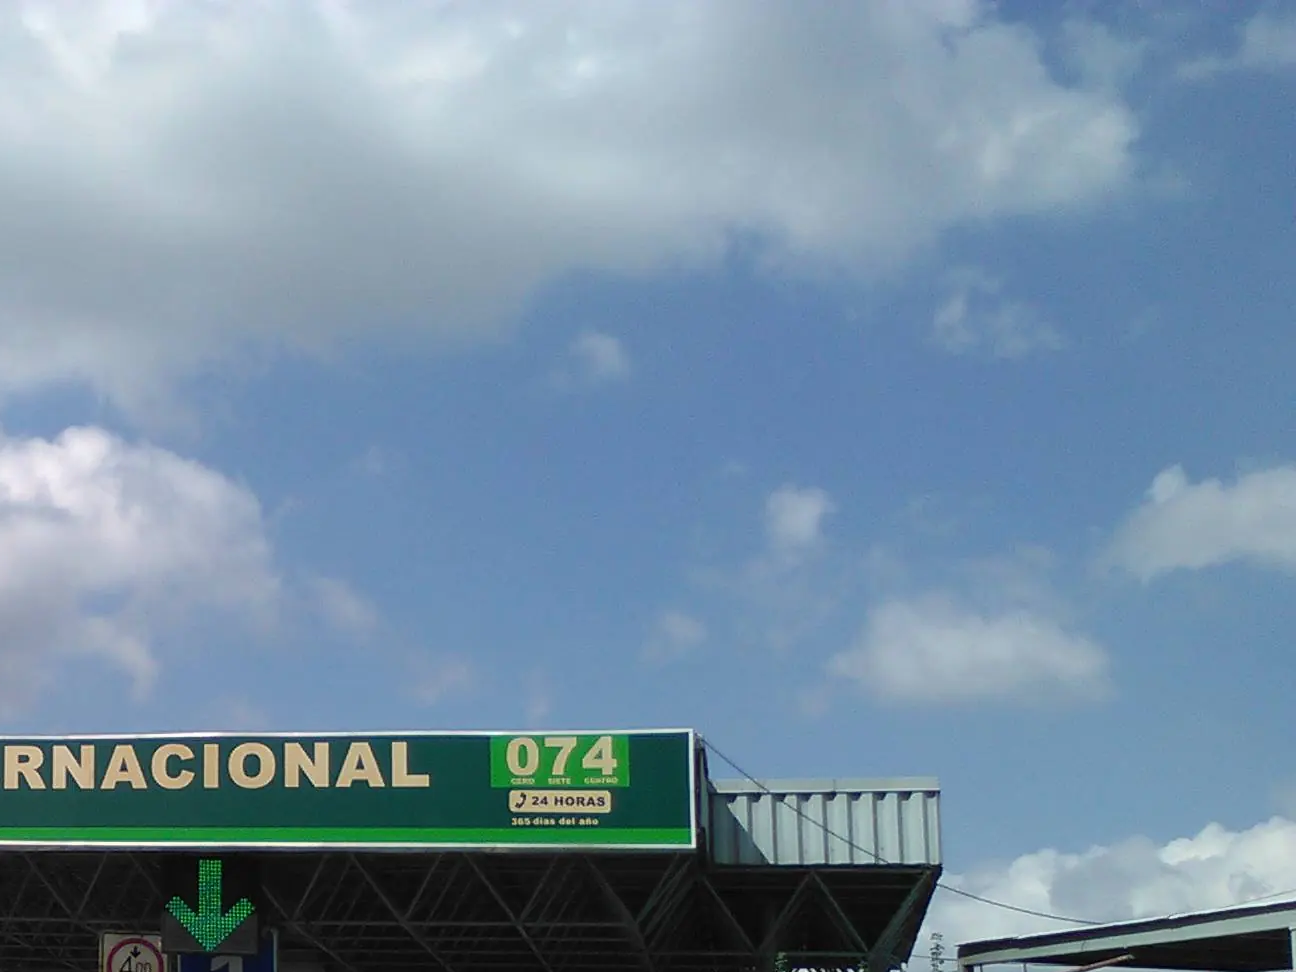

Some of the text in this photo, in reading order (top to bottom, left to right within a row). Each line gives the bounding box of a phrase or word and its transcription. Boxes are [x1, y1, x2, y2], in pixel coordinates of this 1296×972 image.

[506, 735, 618, 776] 074
[531, 796, 606, 807] 24 HORAS
[511, 817, 532, 826] 365
[558, 816, 576, 826] del
